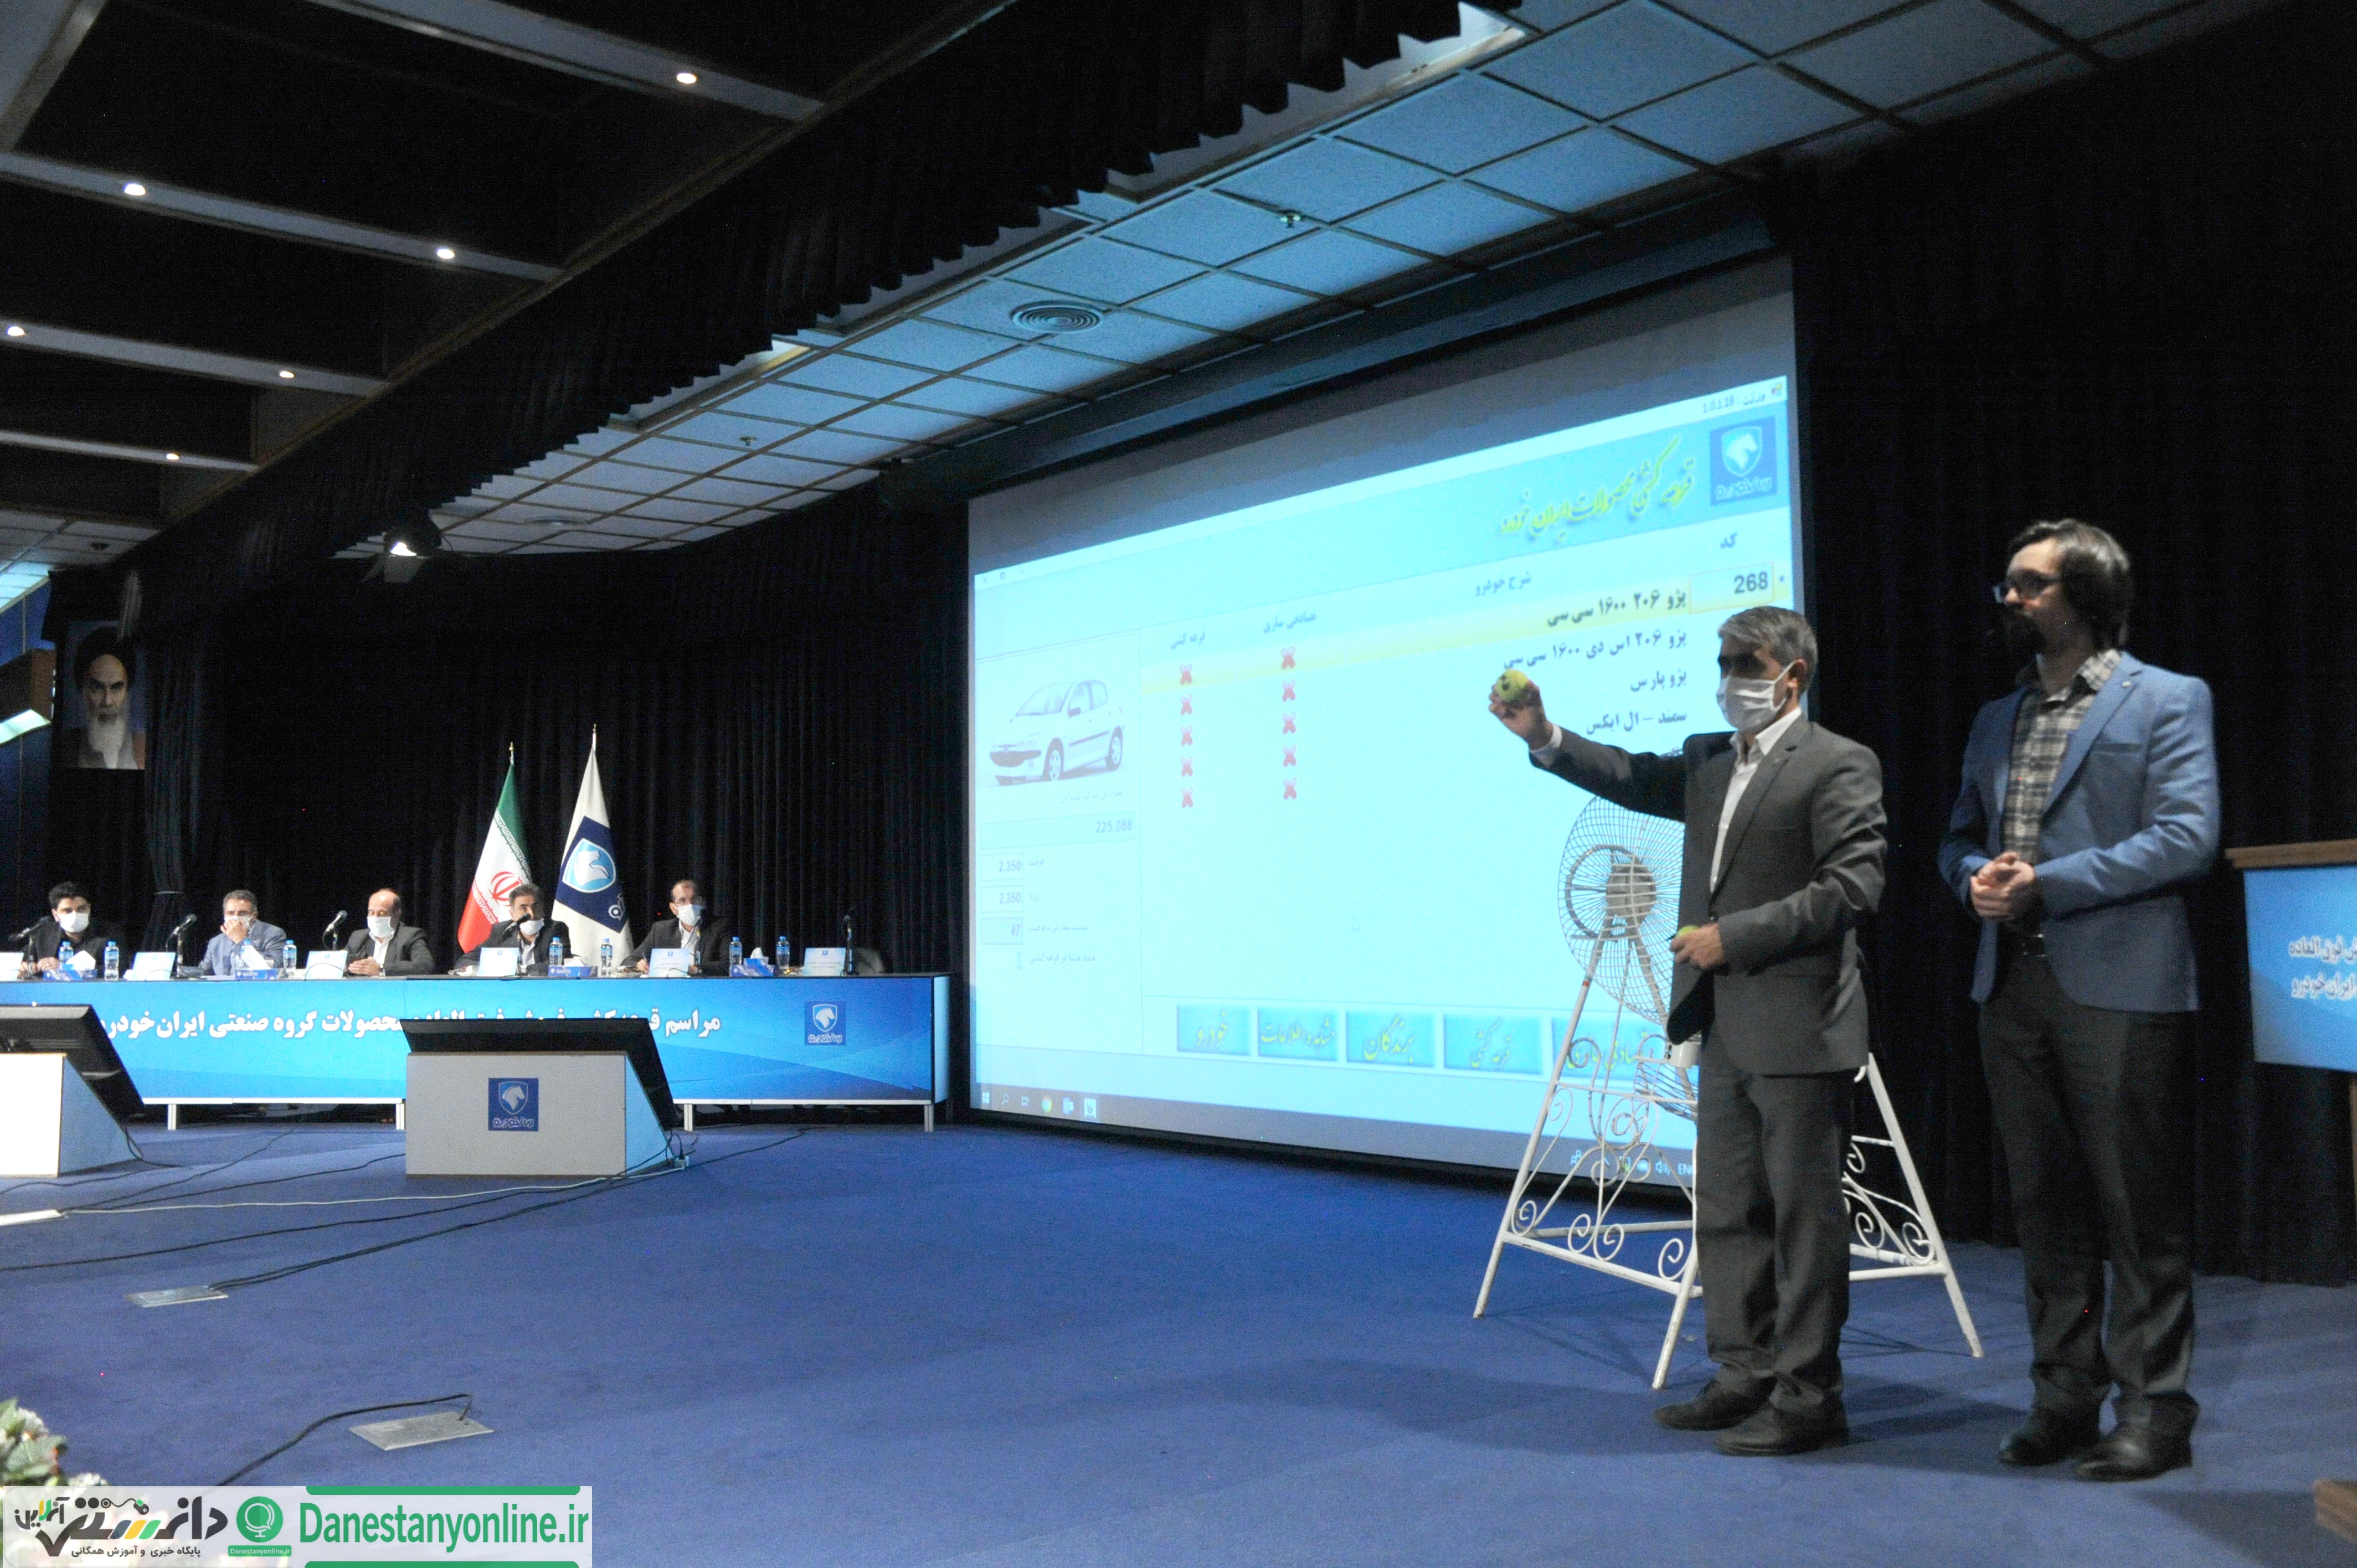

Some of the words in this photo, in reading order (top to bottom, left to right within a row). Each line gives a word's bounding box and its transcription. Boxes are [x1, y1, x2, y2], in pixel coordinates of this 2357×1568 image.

[1734, 571, 1768, 594] 268
[156, 1010, 205, 1038] ایران
[209, 1013, 269, 1039] صنعتی
[273, 1010, 317, 1038] گروه
[666, 1008, 720, 1038] مراسم
